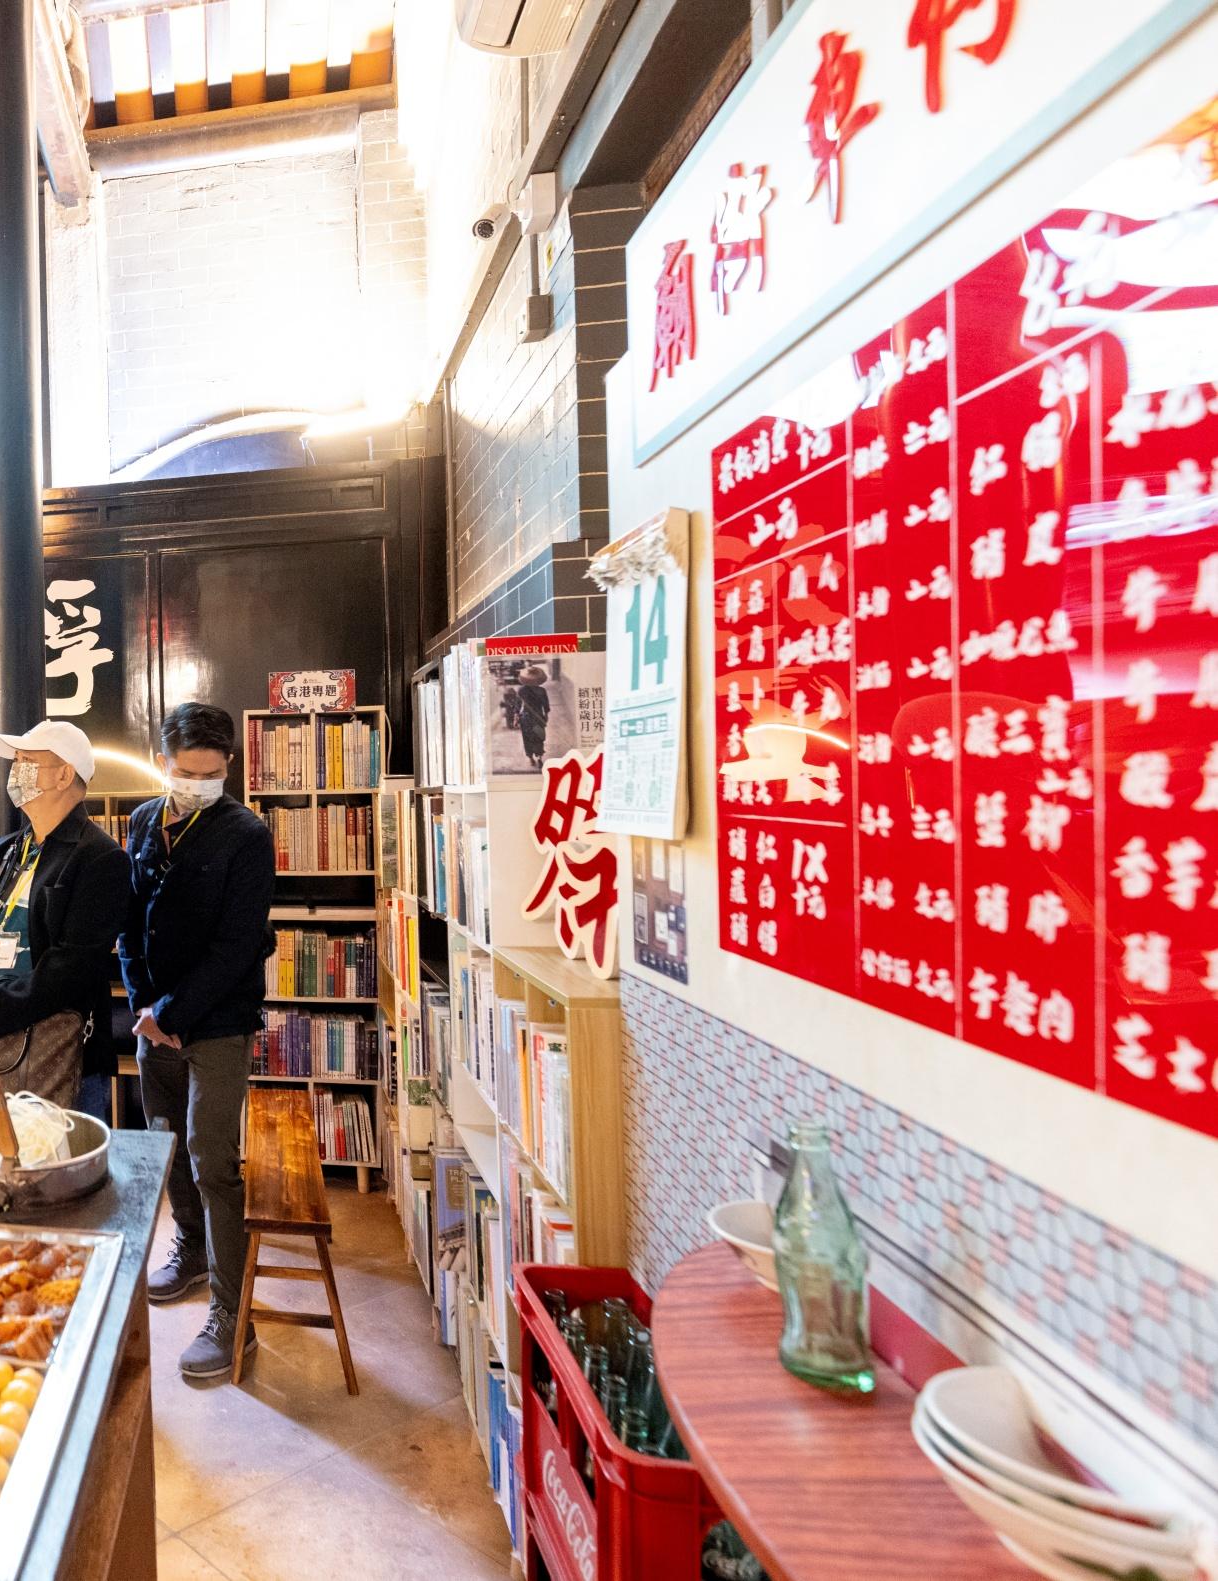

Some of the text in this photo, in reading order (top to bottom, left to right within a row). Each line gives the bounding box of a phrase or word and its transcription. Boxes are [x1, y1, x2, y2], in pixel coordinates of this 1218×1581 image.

[485, 643, 578, 656] DISCOVER CHINA
[625, 574, 669, 692] 14
[286, 684, 337, 698] 香港專題
[578, 688, 590, 732] 繽紛歲月
[592, 687, 604, 732] 黑白以外
